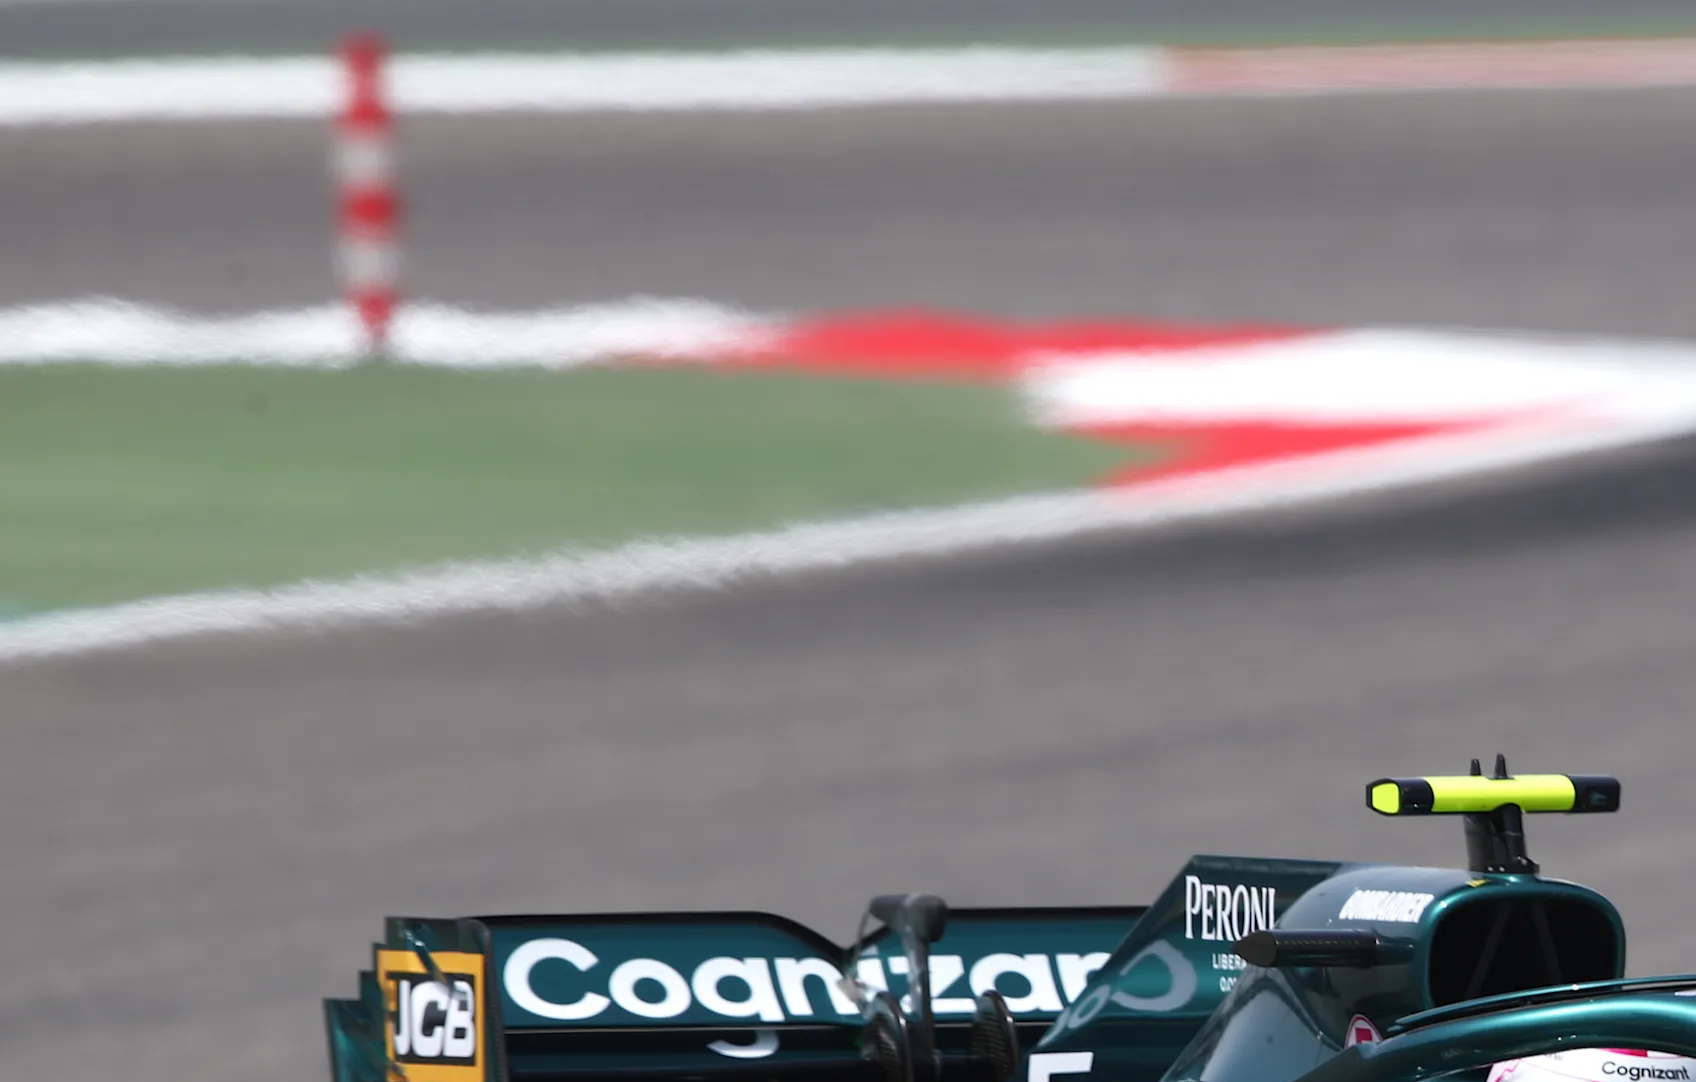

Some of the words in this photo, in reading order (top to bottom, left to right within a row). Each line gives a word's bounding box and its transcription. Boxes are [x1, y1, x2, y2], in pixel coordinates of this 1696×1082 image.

[1185, 875, 1276, 941] PERONI
[394, 980, 475, 1058] JCB
[503, 937, 1112, 1057] Cognizan
[1602, 1061, 1690, 1081] Cognizant
